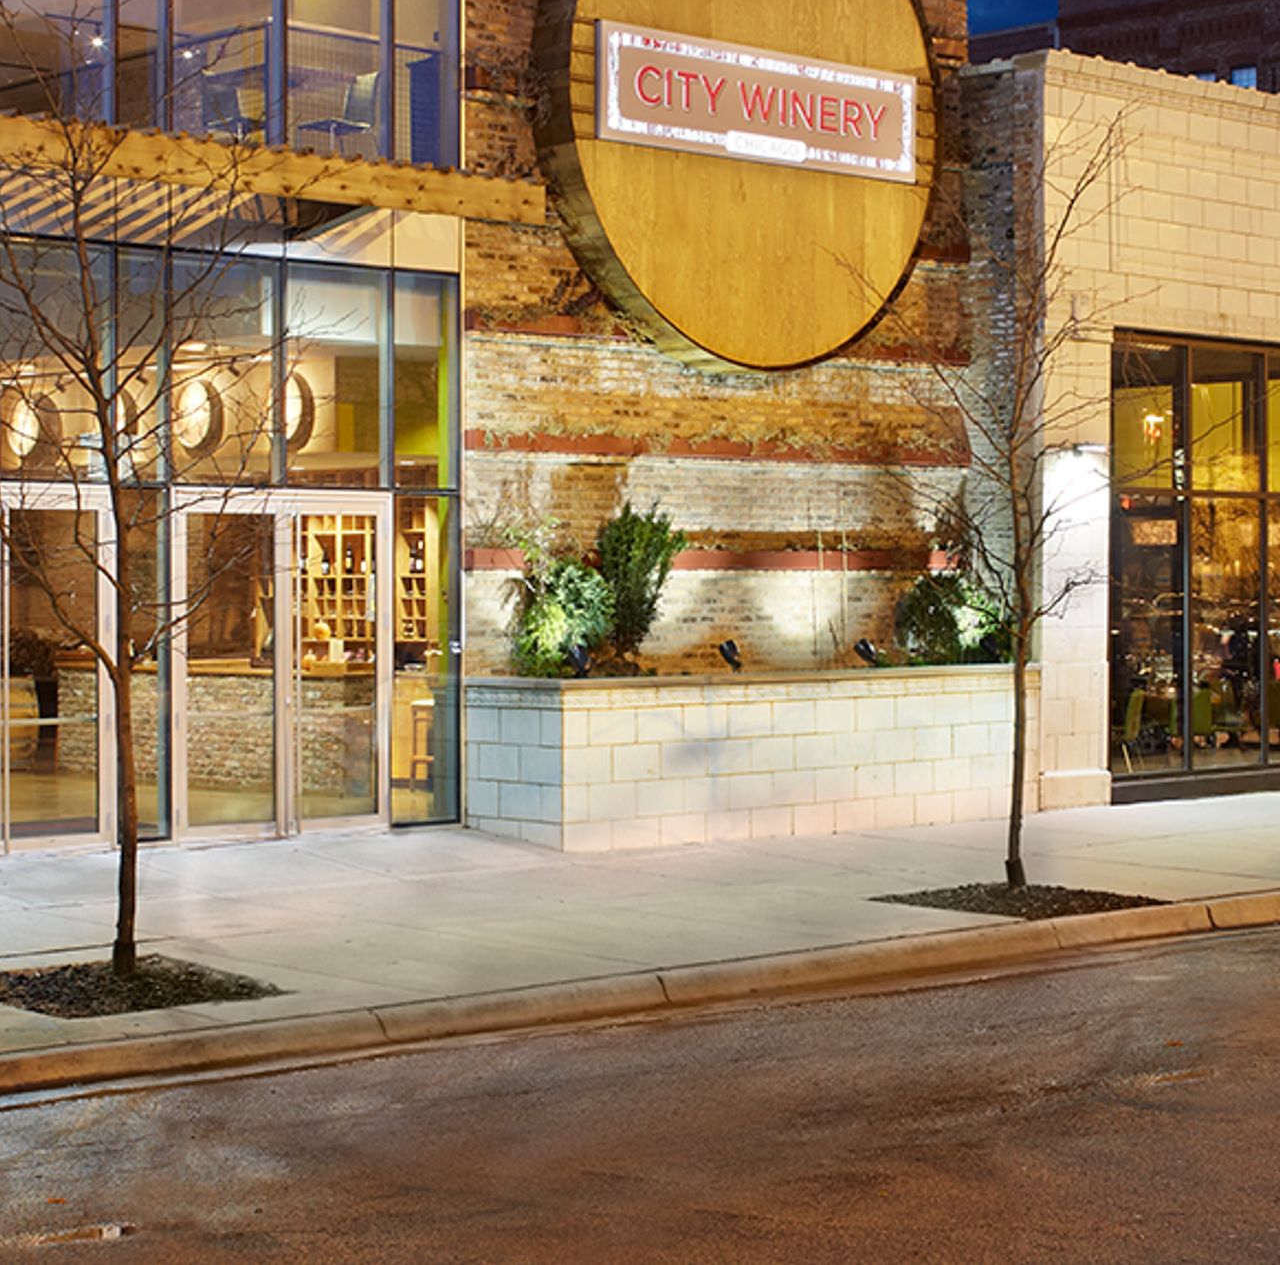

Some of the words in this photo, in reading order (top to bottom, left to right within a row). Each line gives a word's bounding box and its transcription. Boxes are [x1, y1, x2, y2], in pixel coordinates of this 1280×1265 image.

[634, 64, 726, 116] CITY
[737, 80, 887, 141] WINERY
[734, 134, 800, 158] CHICAGO
